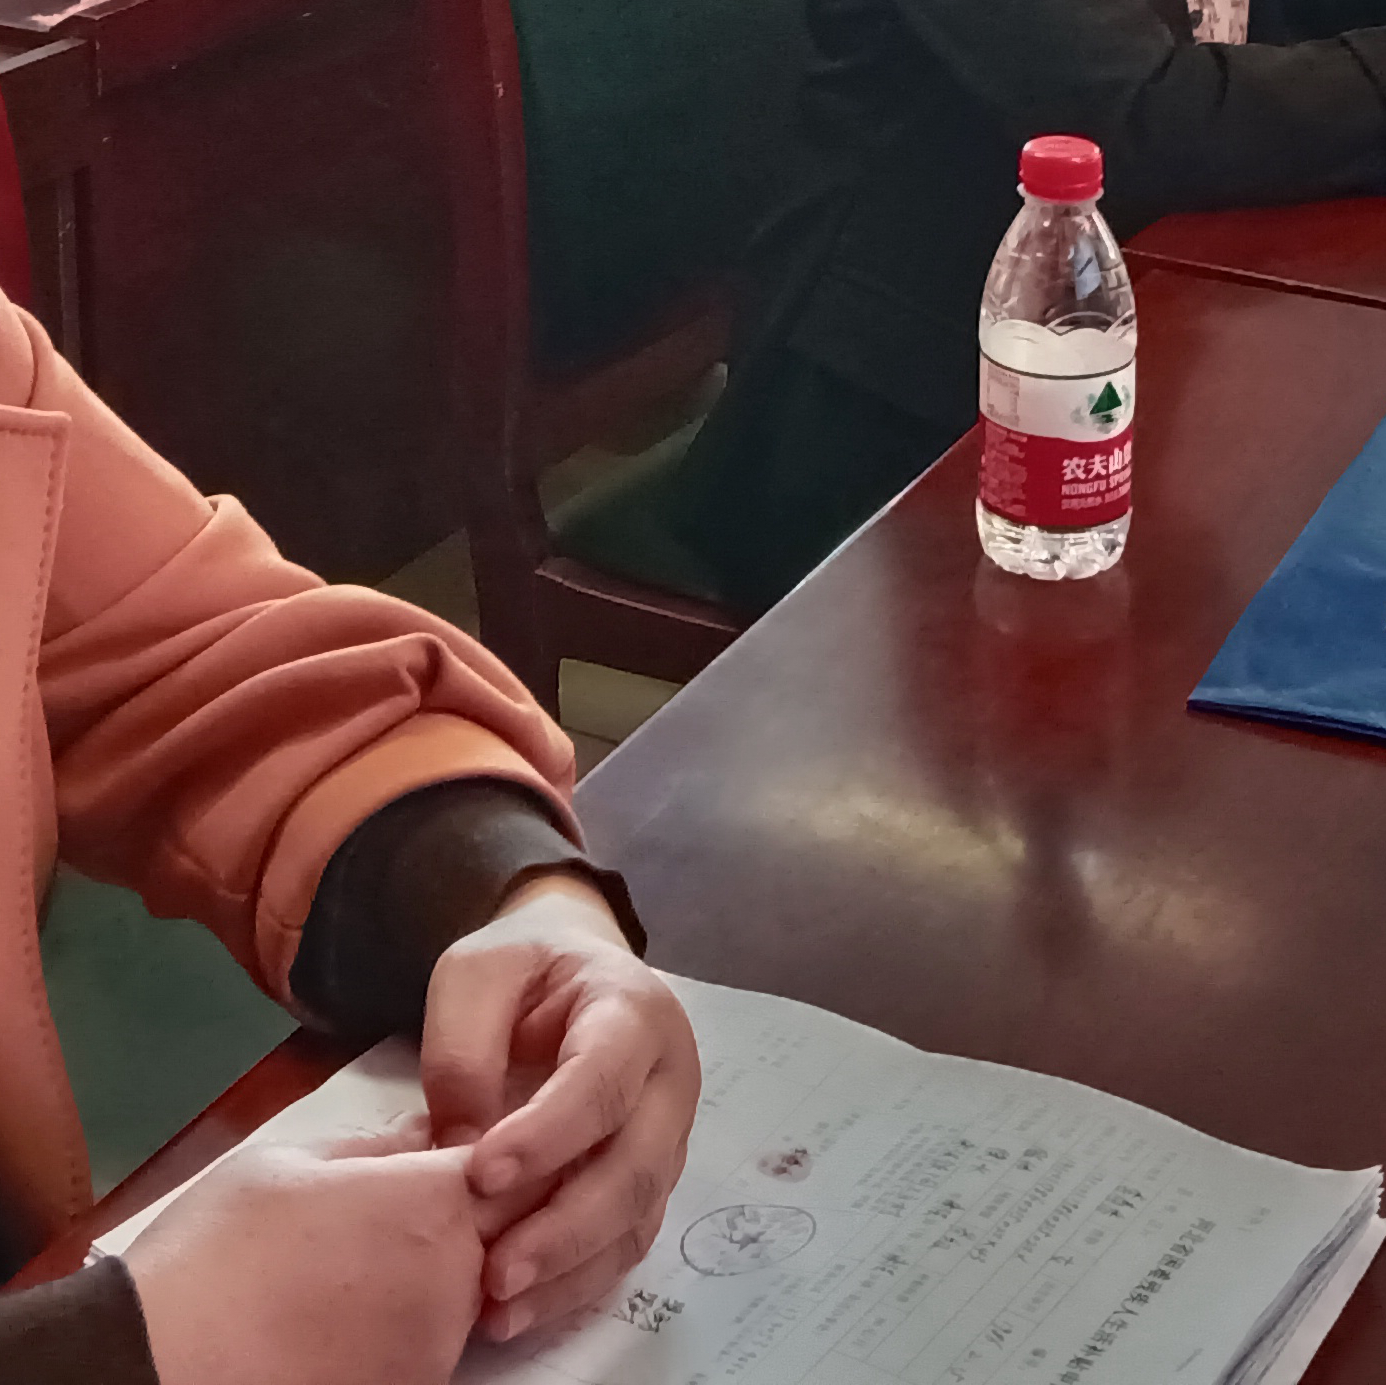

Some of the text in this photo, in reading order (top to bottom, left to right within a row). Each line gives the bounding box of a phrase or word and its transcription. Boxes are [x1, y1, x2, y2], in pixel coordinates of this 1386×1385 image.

[1053, 1217, 1217, 1385] 河北省困难残疾人生活补贴申
